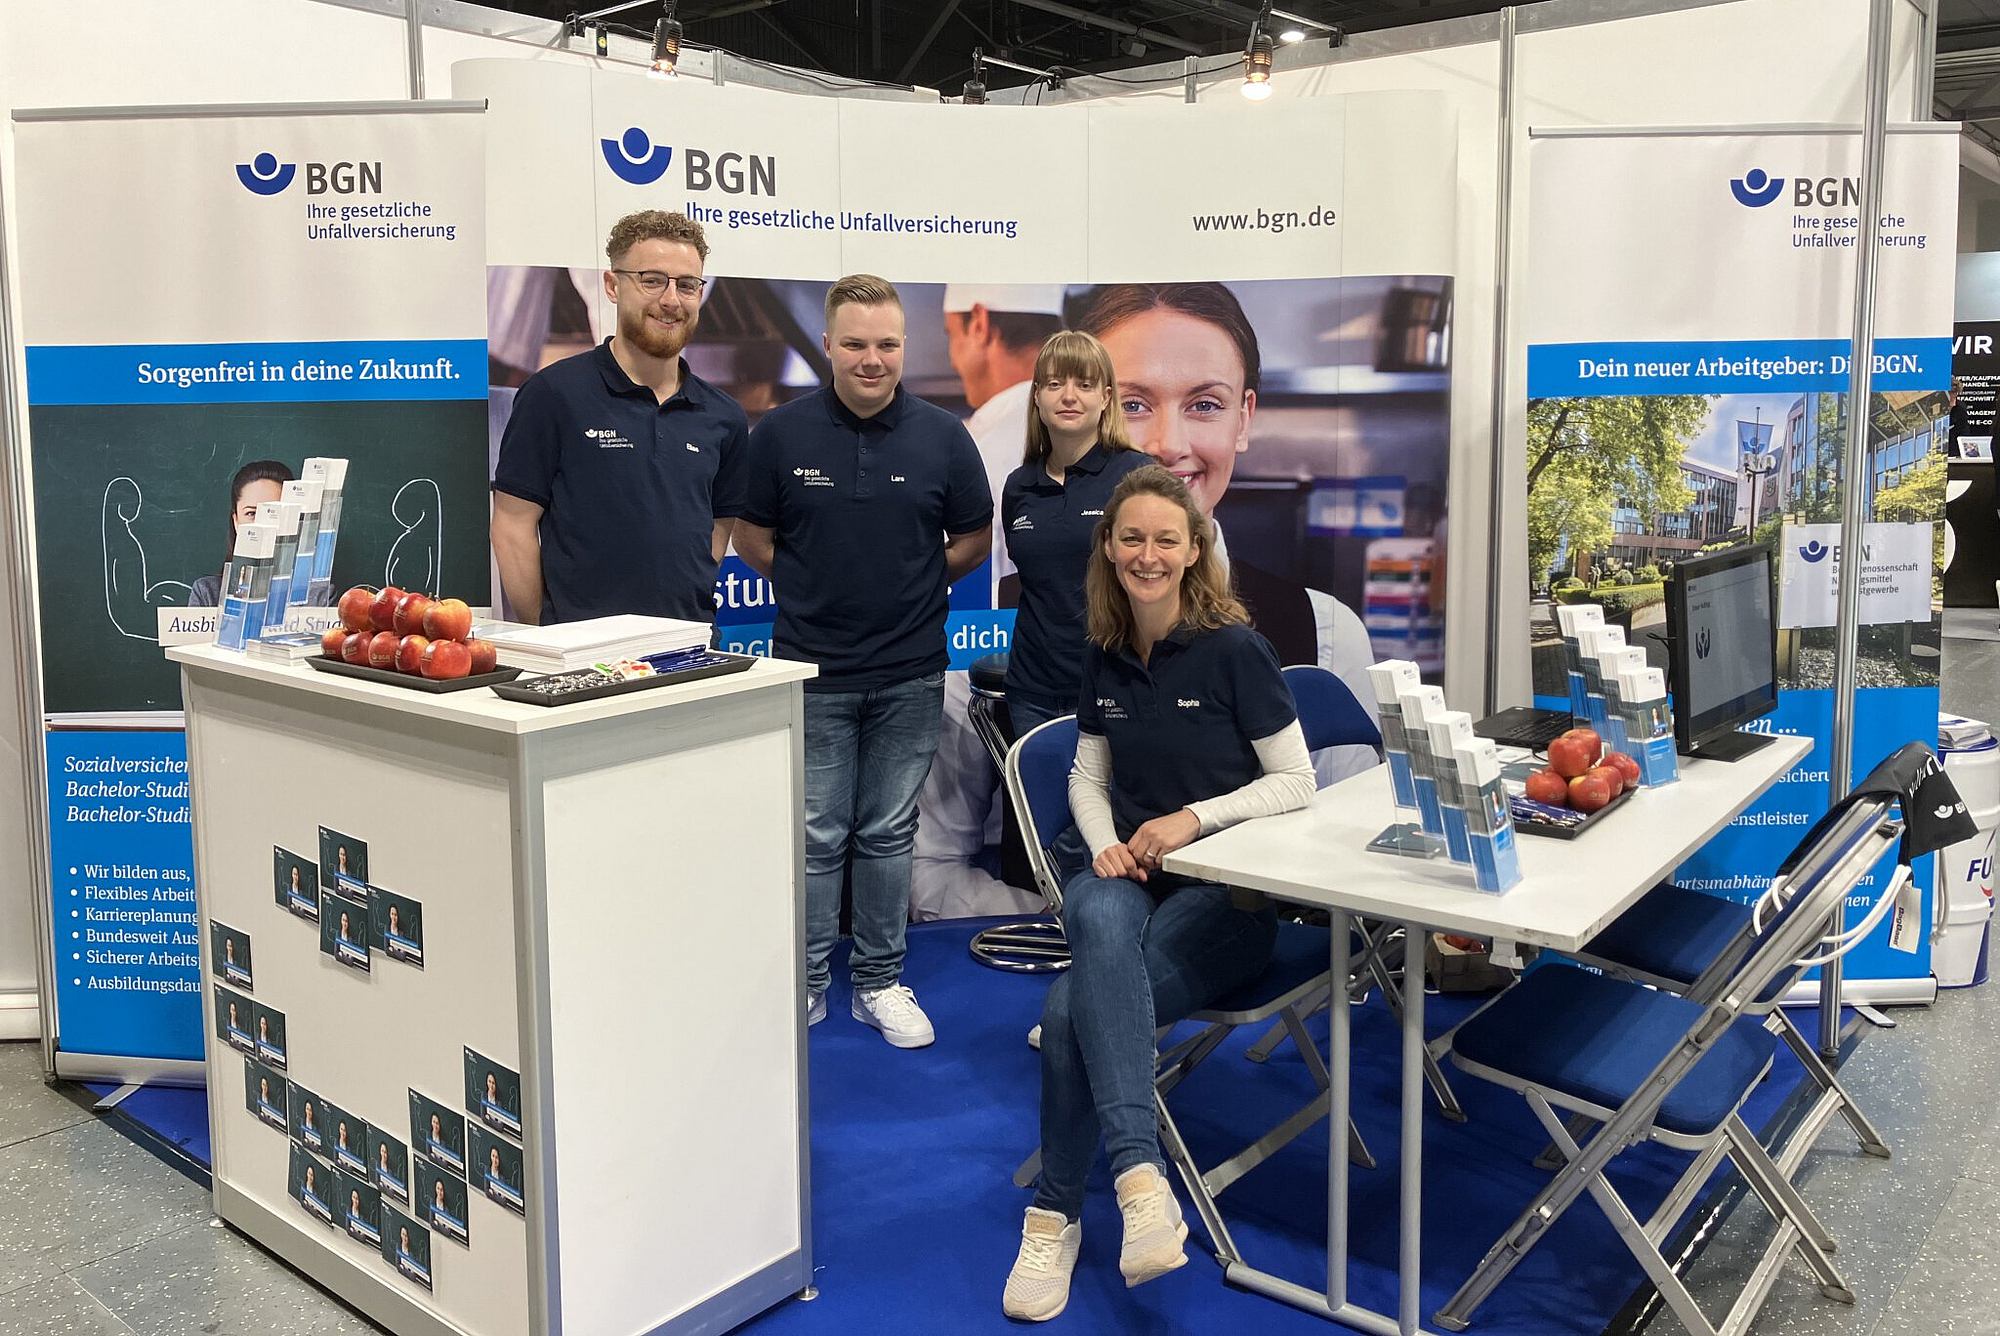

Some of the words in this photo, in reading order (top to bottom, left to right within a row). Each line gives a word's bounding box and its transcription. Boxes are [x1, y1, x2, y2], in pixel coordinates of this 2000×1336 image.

[305, 161, 383, 195] BGN
[684, 149, 776, 196] BGN
[1794, 177, 1861, 207] BGN
[306, 203, 336, 219] Ihre
[341, 202, 432, 221] gesetzliche
[1193, 205, 1336, 233] www.bgn.de
[686, 202, 723, 224] Ihre
[728, 206, 836, 231] gesetzliche
[840, 211, 1019, 239] Unfallversicherung
[1793, 215, 1820, 228] Ihre
[1824, 214, 1905, 231] geseche
[307, 222, 457, 241] Unfallversicherung
[1792, 233, 1927, 249] Unfallvererung
[138, 361, 256, 387] Sorgenfrei
[261, 363, 285, 382] in
[290, 360, 354, 382] deine
[359, 357, 461, 380] Zukunft.
[1578, 359, 1629, 379] Dein
[1634, 363, 1690, 377] neuer
[1695, 356, 1825, 380] Arbeitgeber:
[1830, 356, 1851, 374] Di
[1872, 355, 1924, 374] BGN.
[598, 429, 617, 438] BGN
[890, 474, 905, 482] Lars
[1833, 545, 1870, 562] BN
[1832, 575, 1892, 584] Ngsmittel
[1859, 585, 1899, 596] stgewerbe
[952, 623, 1008, 650] dich
[66, 781, 189, 798] Bachelor-Studi
[1728, 811, 1809, 826] enstleister
[84, 865, 109, 879] Wir
[113, 865, 158, 879] bilden
[162, 868, 191, 882] aus,
[1966, 855, 1994, 882] FU
[84, 886, 148, 901] Flexibles
[152, 887, 195, 902] Arbeit
[85, 908, 198, 926] Karriereplanung
[86, 928, 168, 945] Bundesweit
[172, 931, 198, 945] Aus
[86, 950, 145, 965] Sicherer
[87, 976, 201, 994] Ausbildungsdau
